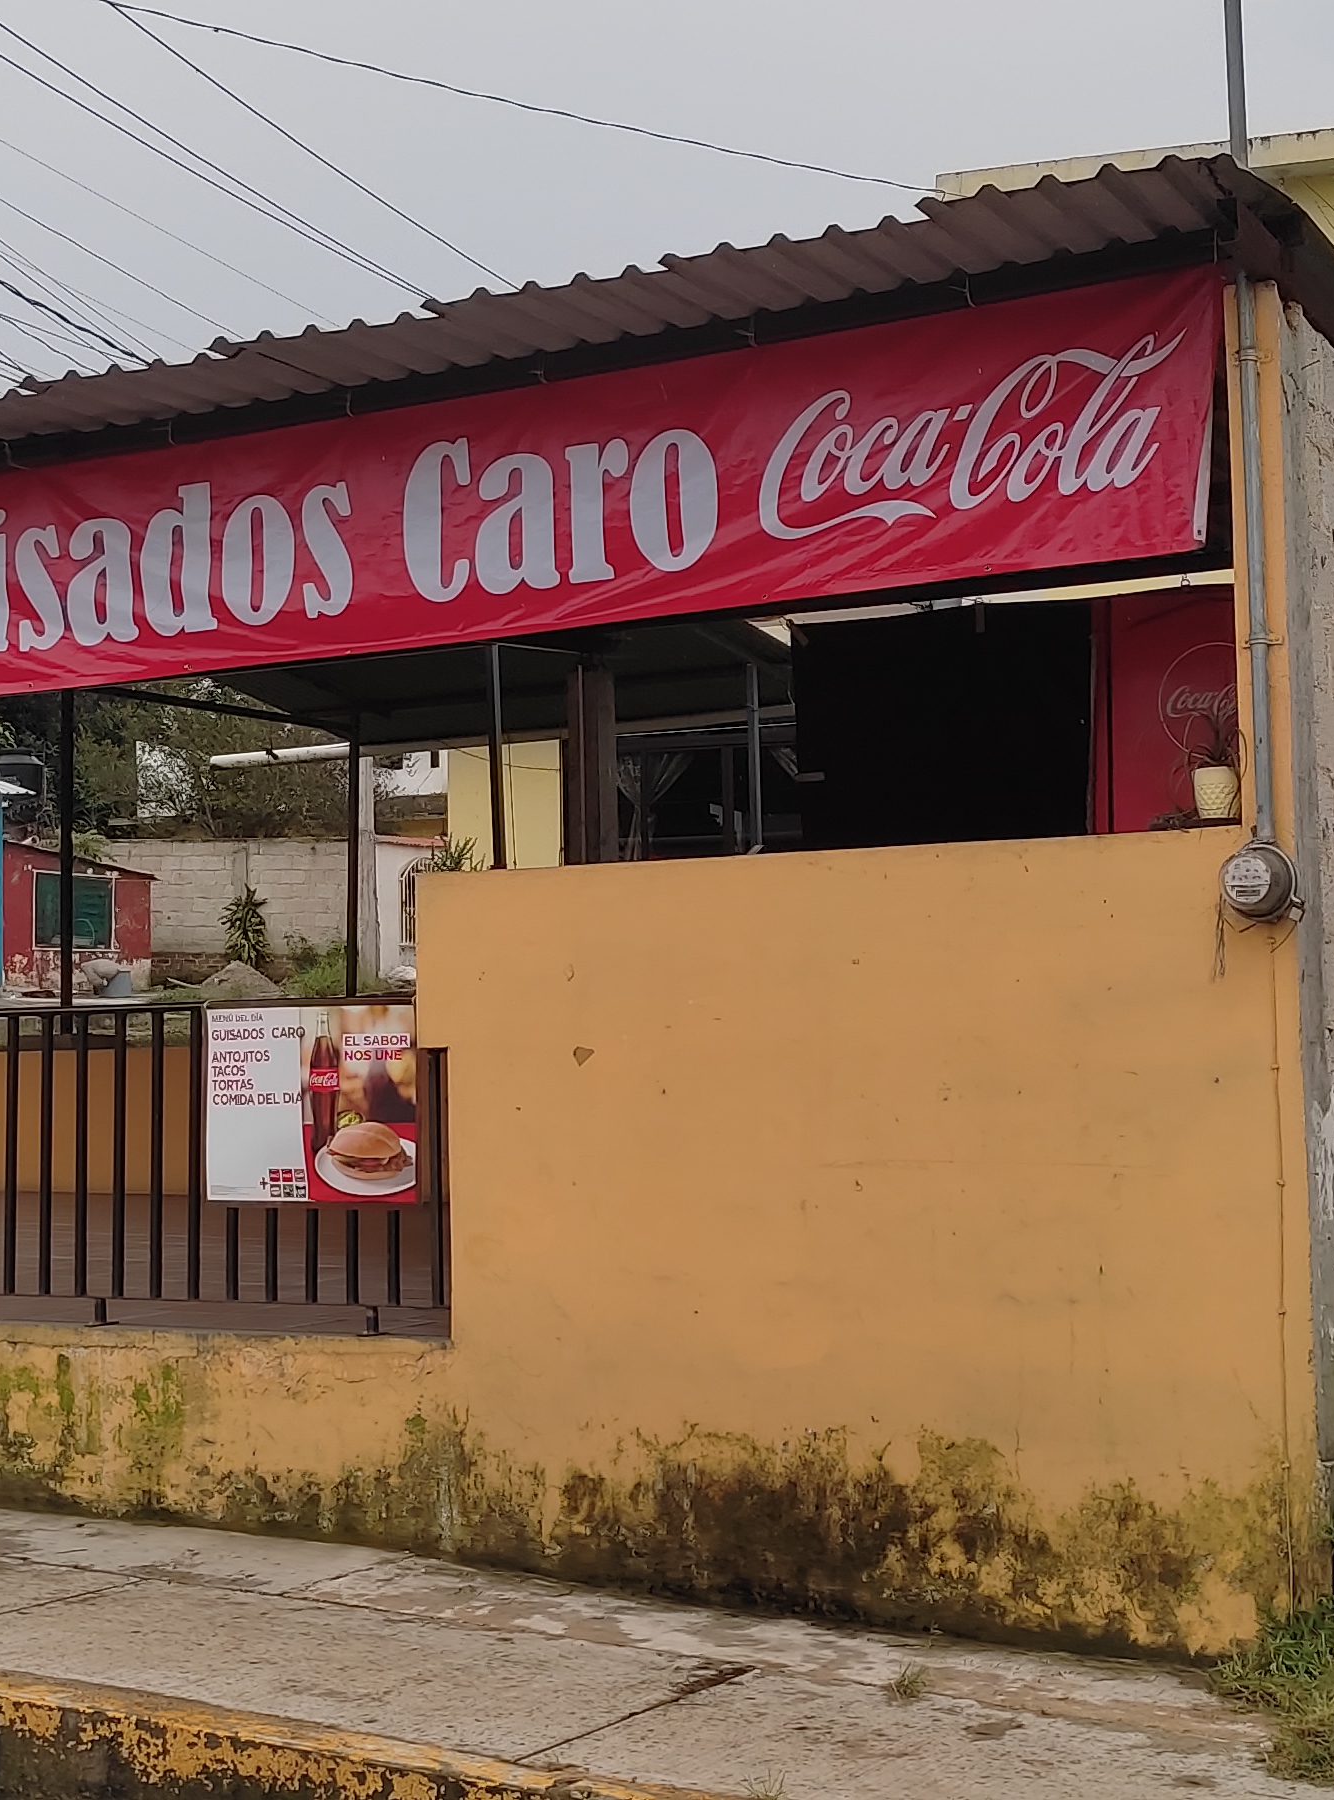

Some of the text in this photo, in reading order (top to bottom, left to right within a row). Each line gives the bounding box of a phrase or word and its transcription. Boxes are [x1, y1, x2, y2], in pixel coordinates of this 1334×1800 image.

[402, 427, 719, 603] Caro
[759, 327, 1188, 539] Coca-Cola
[212, 1013, 233, 1022] MENÚ
[236, 1014, 249, 1022] DEL
[212, 1026, 306, 1041] GUISADOS CARO
[344, 1036, 408, 1046] EL SABOR
[212, 1050, 270, 1063] ANTOJITOS
[344, 1049, 403, 1061] NOS UNE
[211, 1065, 246, 1077] TACOS
[212, 1079, 254, 1091] TORTAS
[212, 1093, 255, 1105] COMIDA
[258, 1093, 280, 1104] DEL
